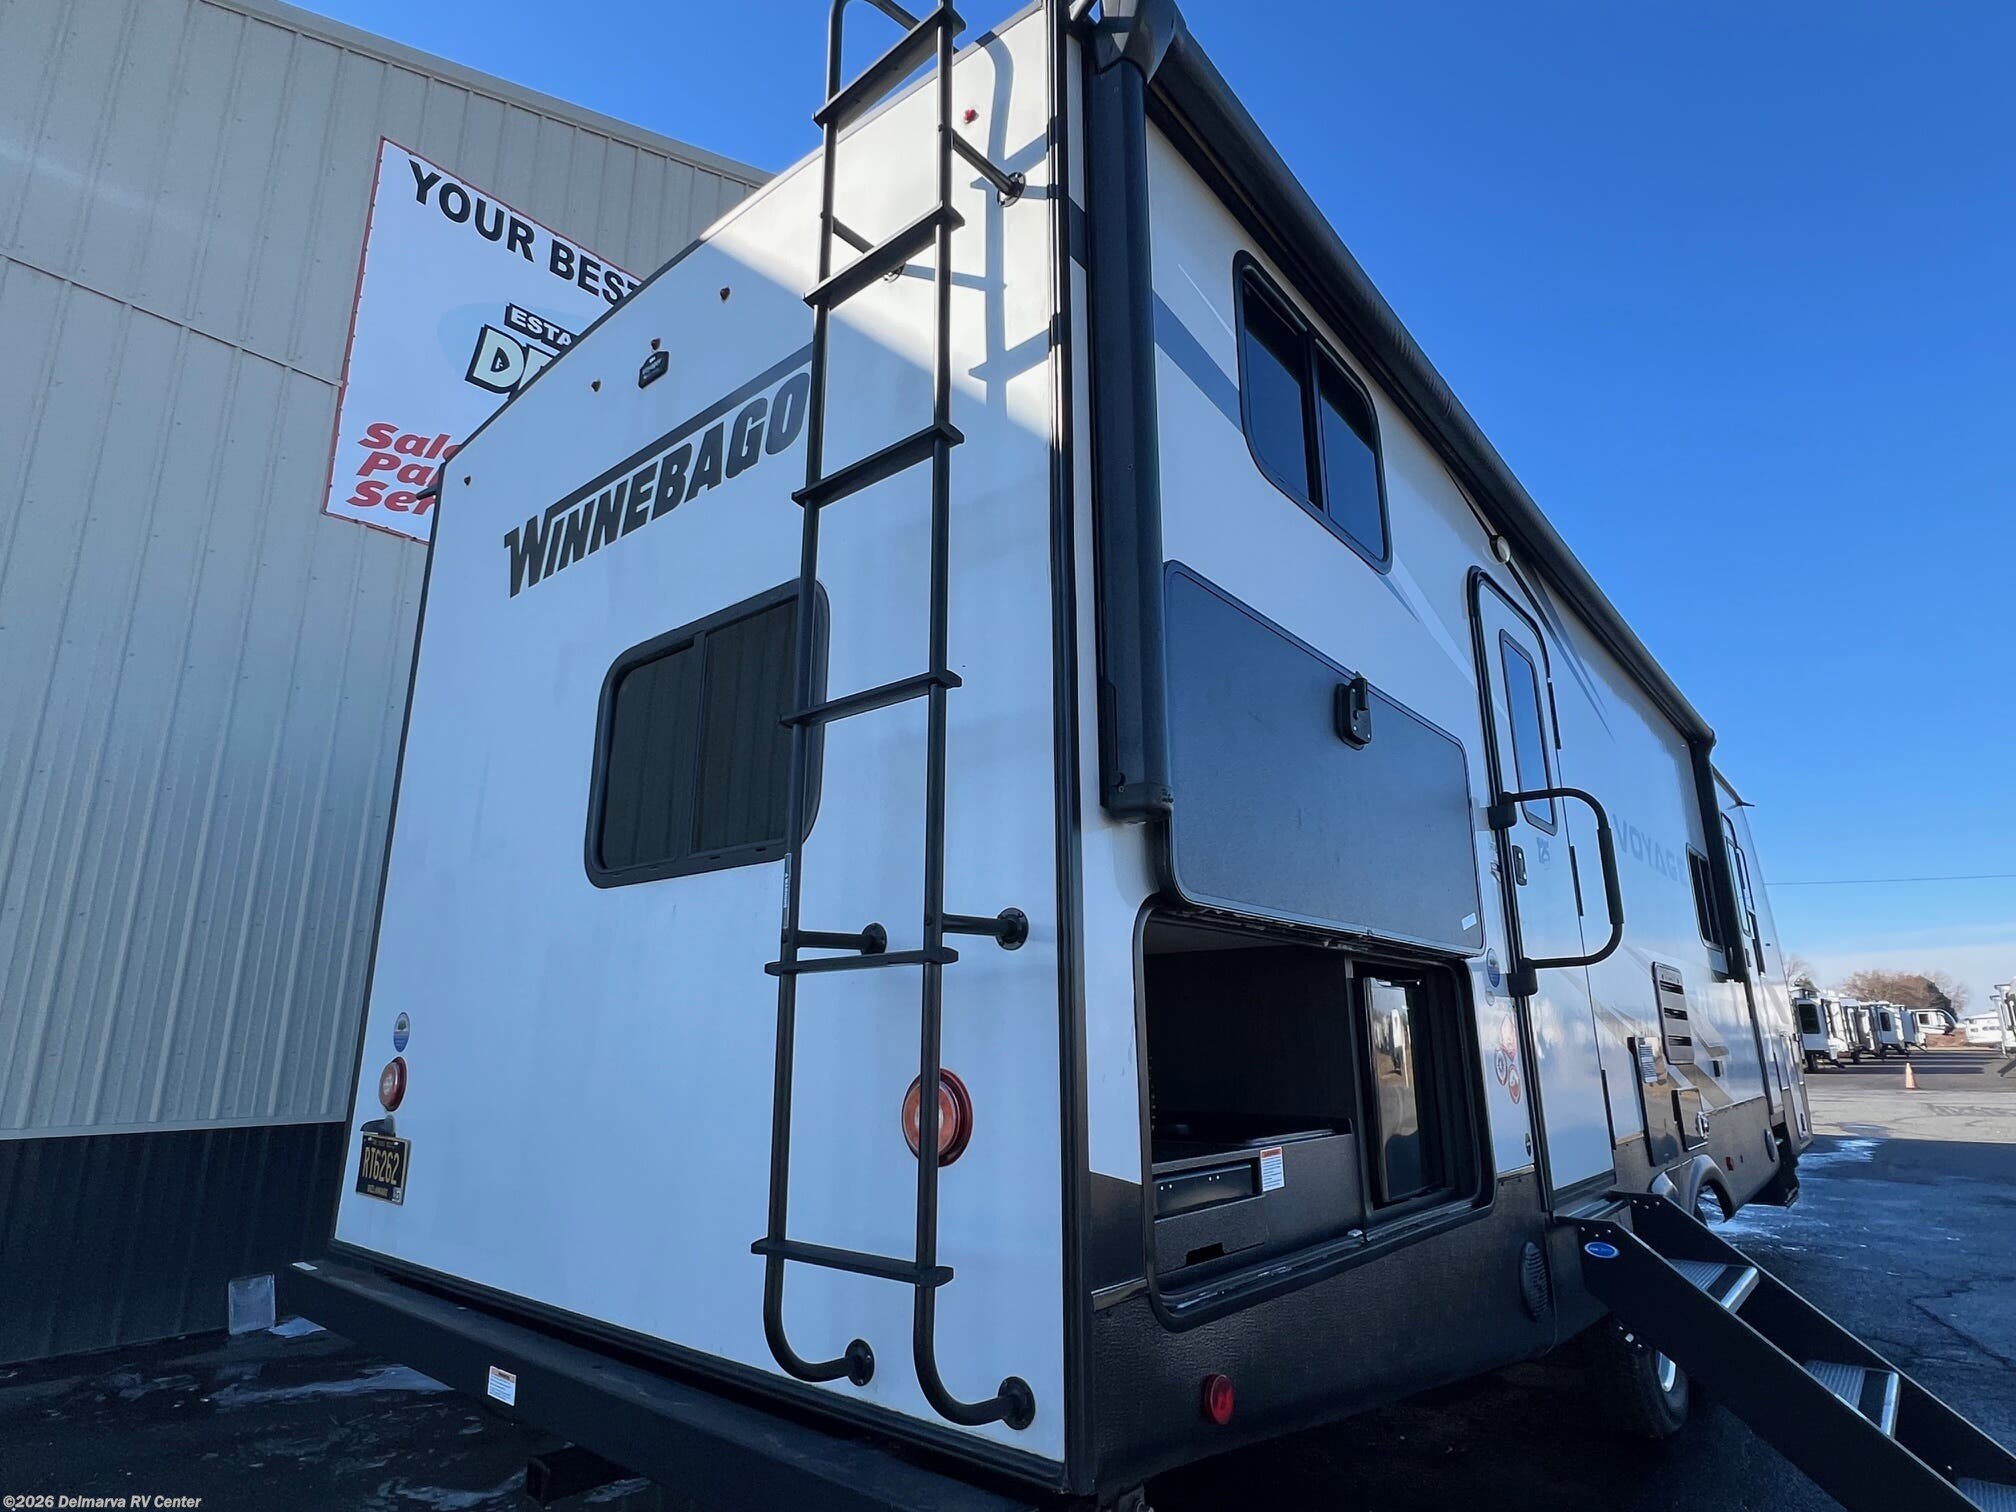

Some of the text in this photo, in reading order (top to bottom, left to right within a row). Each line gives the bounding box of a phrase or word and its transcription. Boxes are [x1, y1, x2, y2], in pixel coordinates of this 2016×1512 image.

[408, 160, 534, 262] YOUR
[504, 372, 811, 598] WINNEBAGO
[362, 1146, 400, 1185] RT6262
